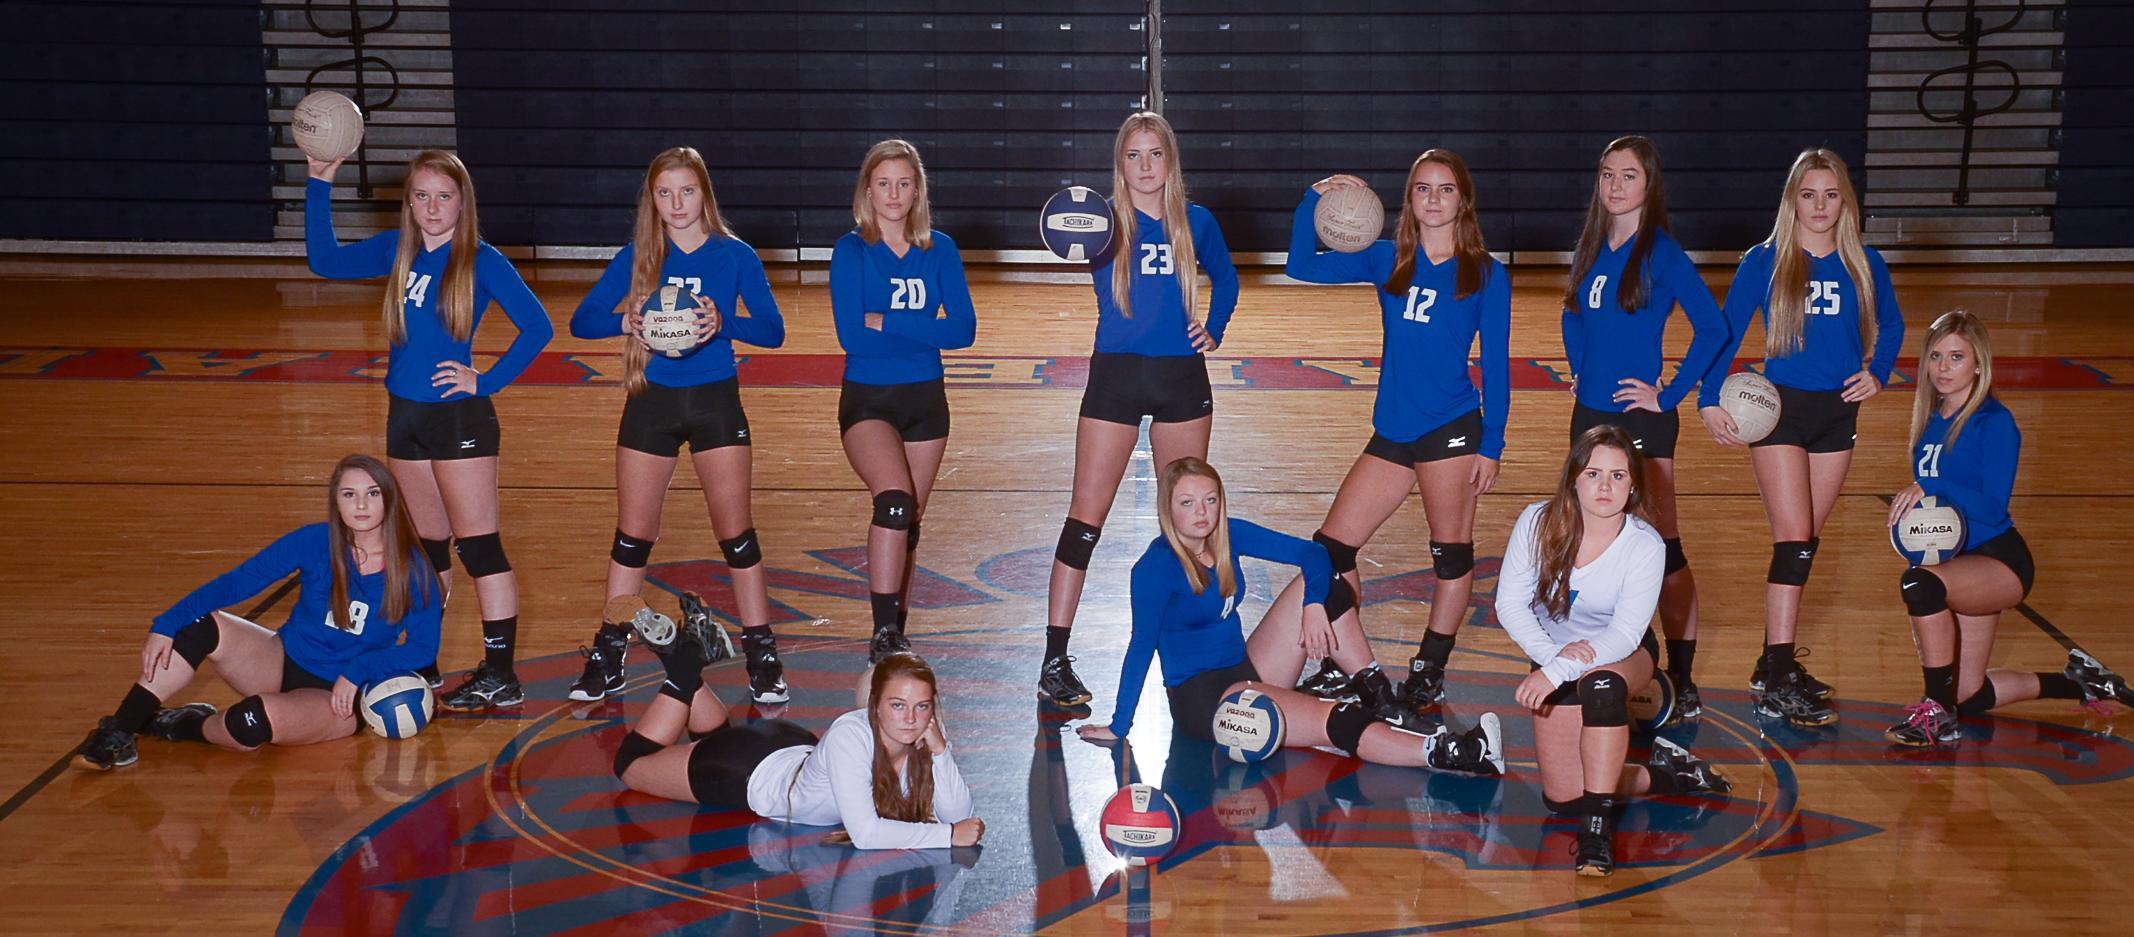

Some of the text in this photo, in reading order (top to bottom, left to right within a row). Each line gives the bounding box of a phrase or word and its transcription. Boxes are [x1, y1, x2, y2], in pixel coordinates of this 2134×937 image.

[1323, 226, 1361, 242] molten
[1141, 243, 1174, 275] 23
[890, 277, 926, 310] 20
[1403, 285, 1437, 324] 12
[1589, 275, 1608, 309] 8
[1804, 280, 1841, 315] 25
[650, 328, 691, 339] MiKASA
[1739, 390, 1777, 412] molten
[1918, 443, 1943, 477] 21
[1909, 524, 1953, 535] MiKASA
[1218, 719, 1258, 736] MiKASA
[1123, 830, 1156, 840] TACHIKARA
